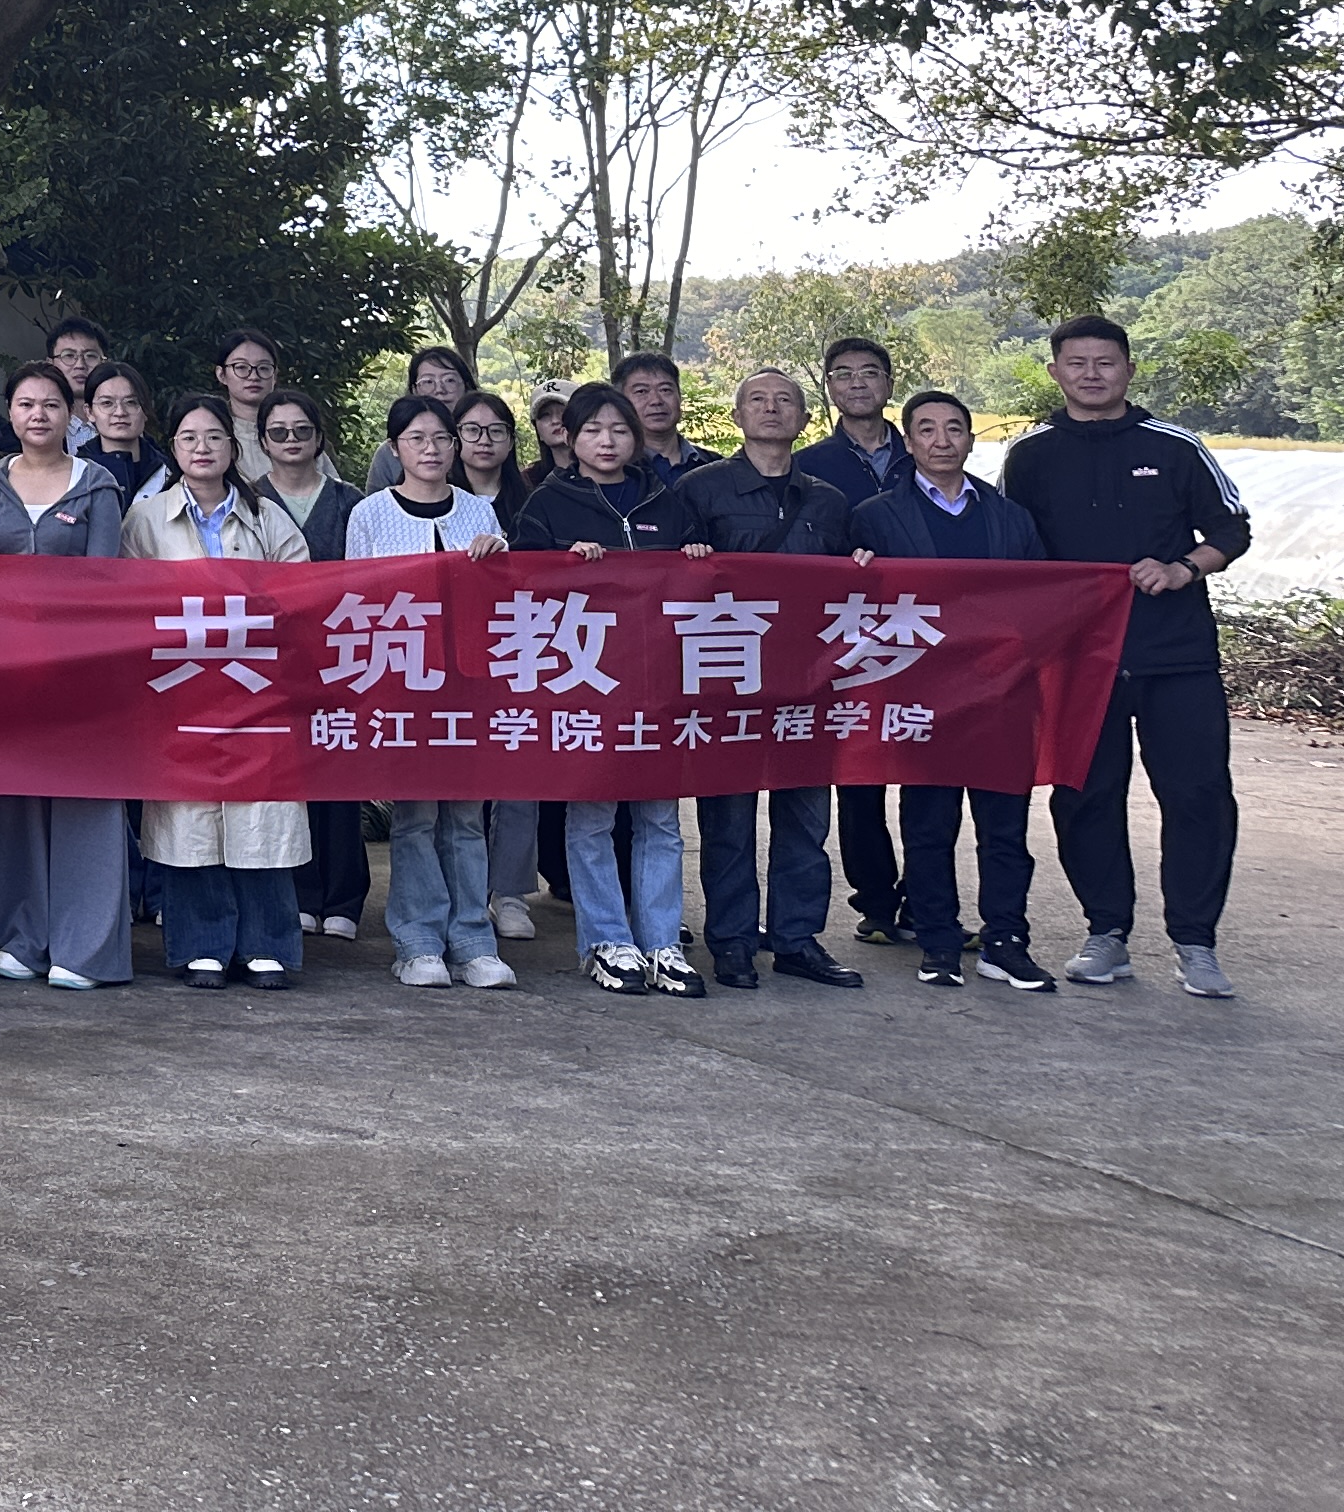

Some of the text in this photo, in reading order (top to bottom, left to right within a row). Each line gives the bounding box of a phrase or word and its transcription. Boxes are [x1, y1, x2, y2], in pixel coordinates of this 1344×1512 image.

[147, 590, 946, 695] 共筑教育梦
